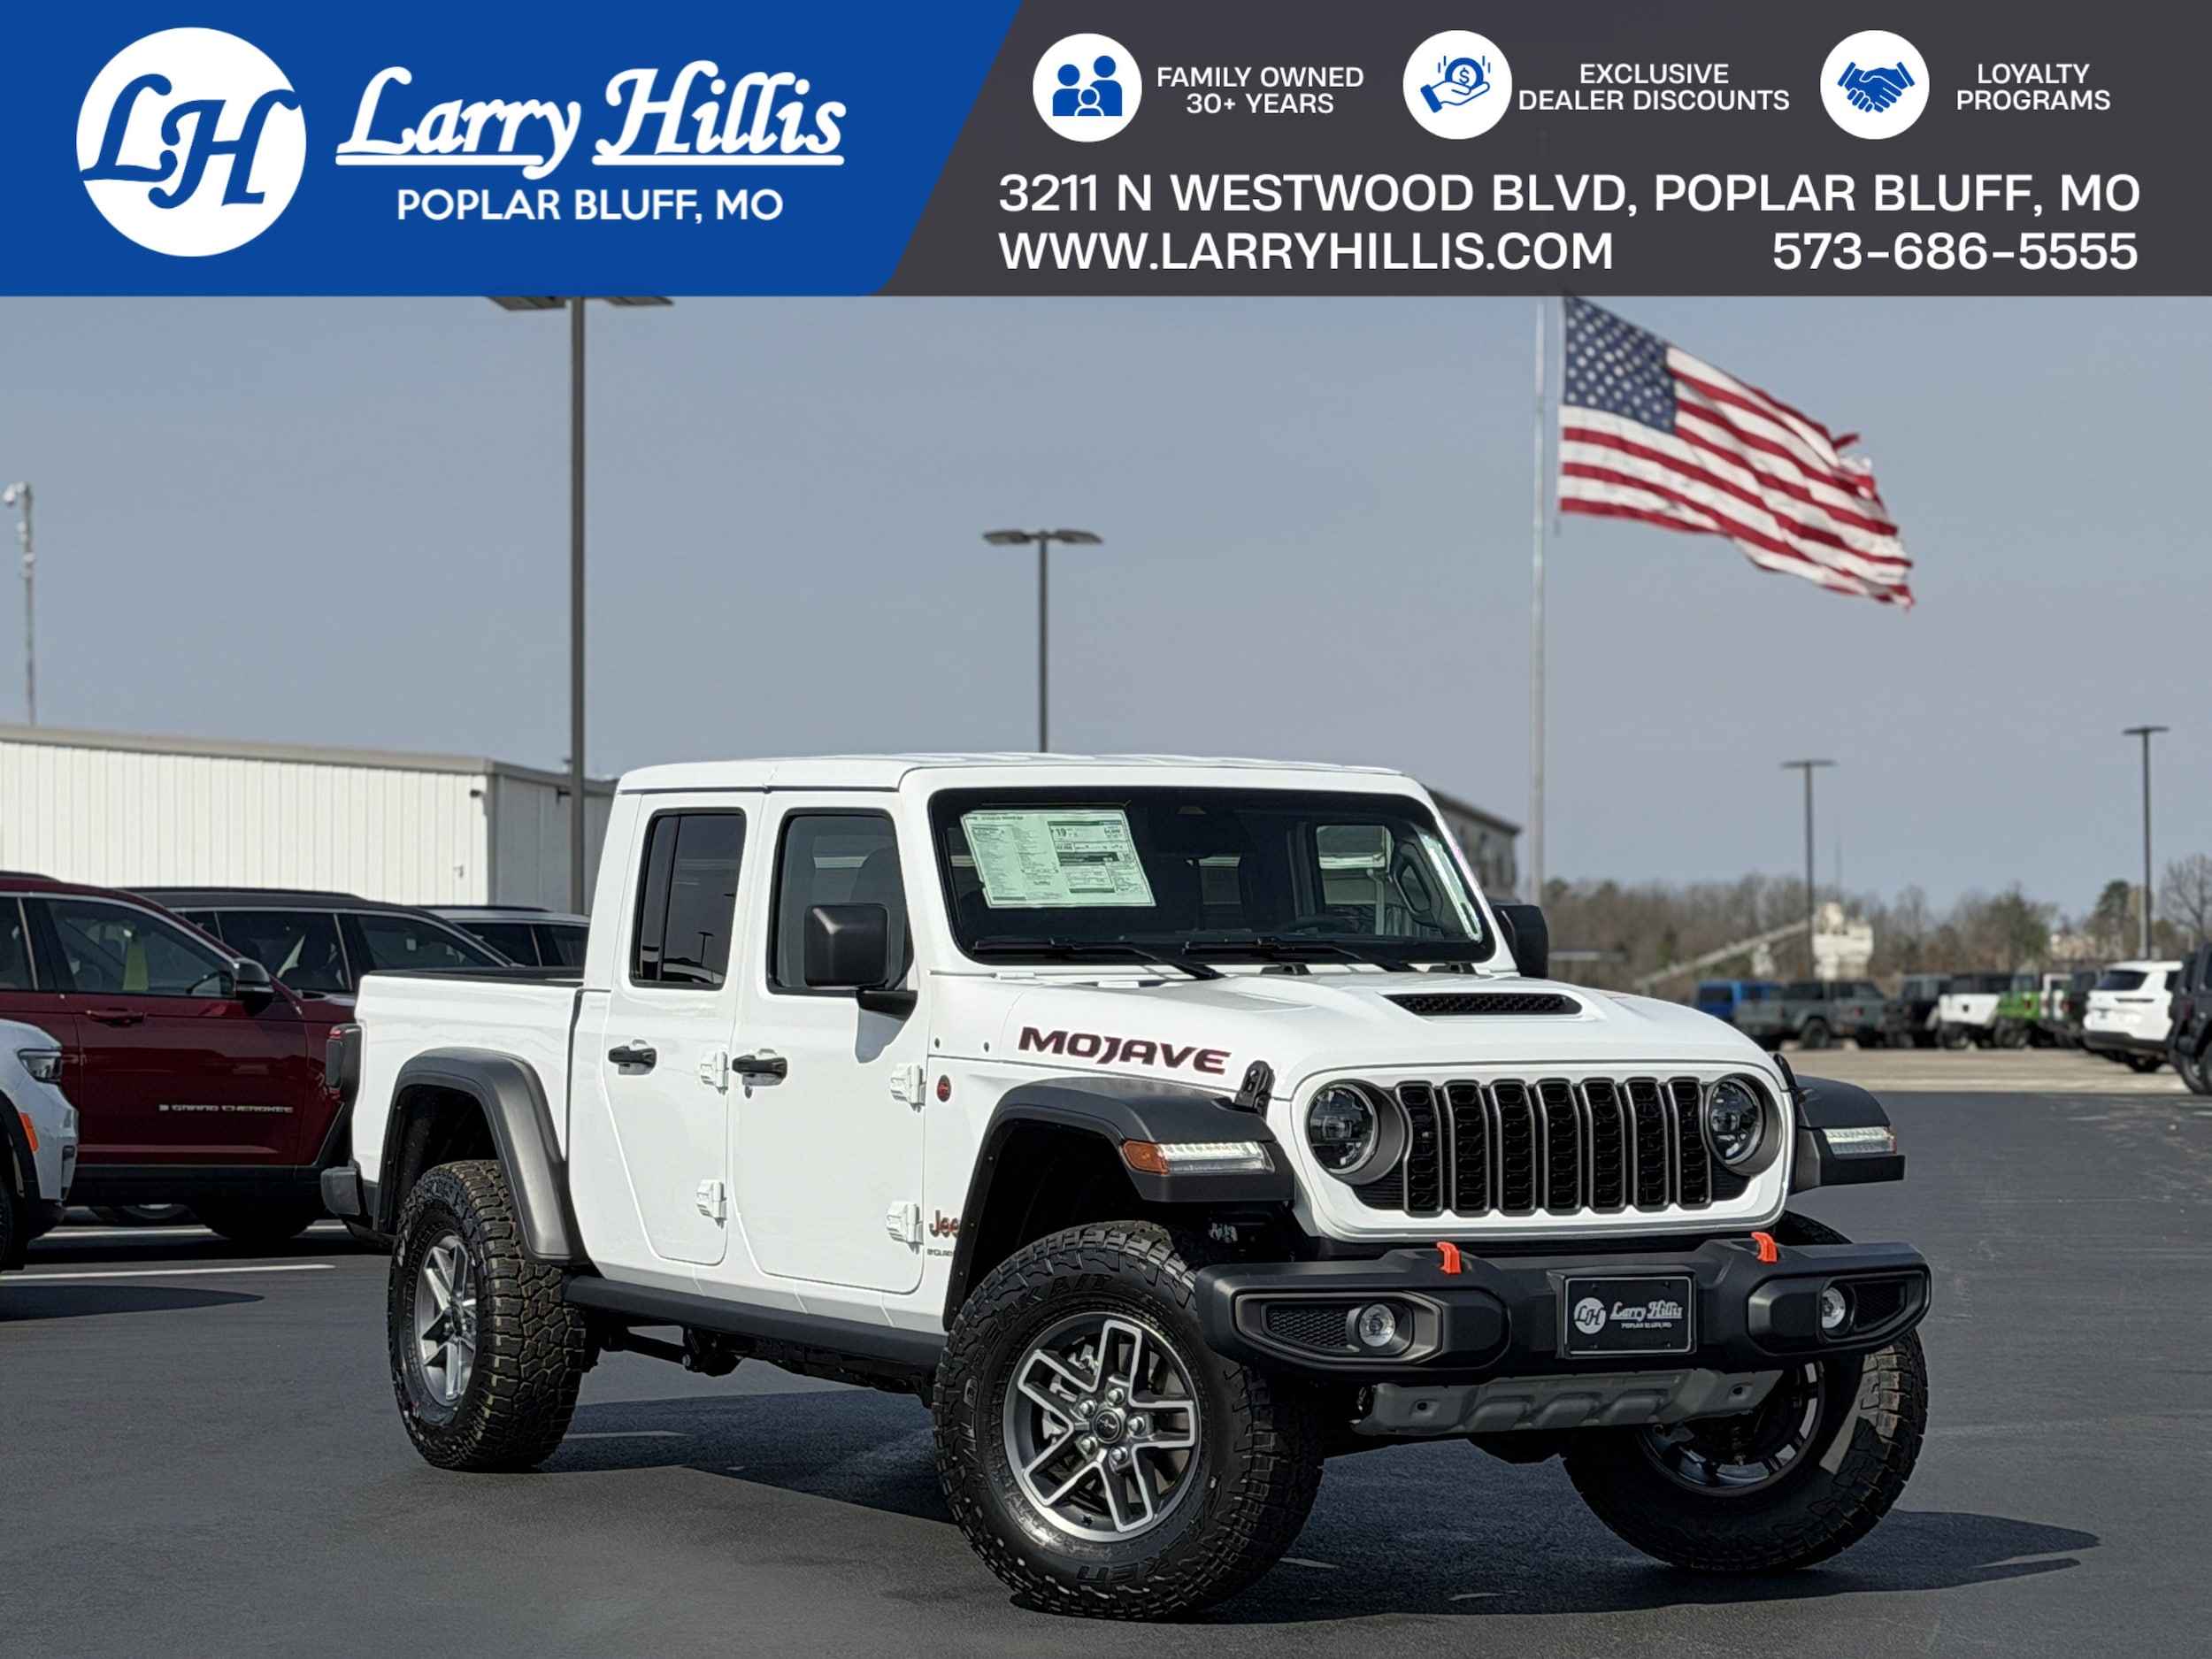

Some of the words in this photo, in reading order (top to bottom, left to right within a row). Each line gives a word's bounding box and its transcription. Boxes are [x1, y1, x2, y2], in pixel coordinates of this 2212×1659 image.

[1018, 1026, 1232, 1075] MOJAVE
[221, 1104, 294, 1114] CHEROKEE
[929, 1210, 959, 1238] Jee
[1610, 1302, 1646, 1321] Larry
[1647, 1300, 1682, 1319] Hillis
